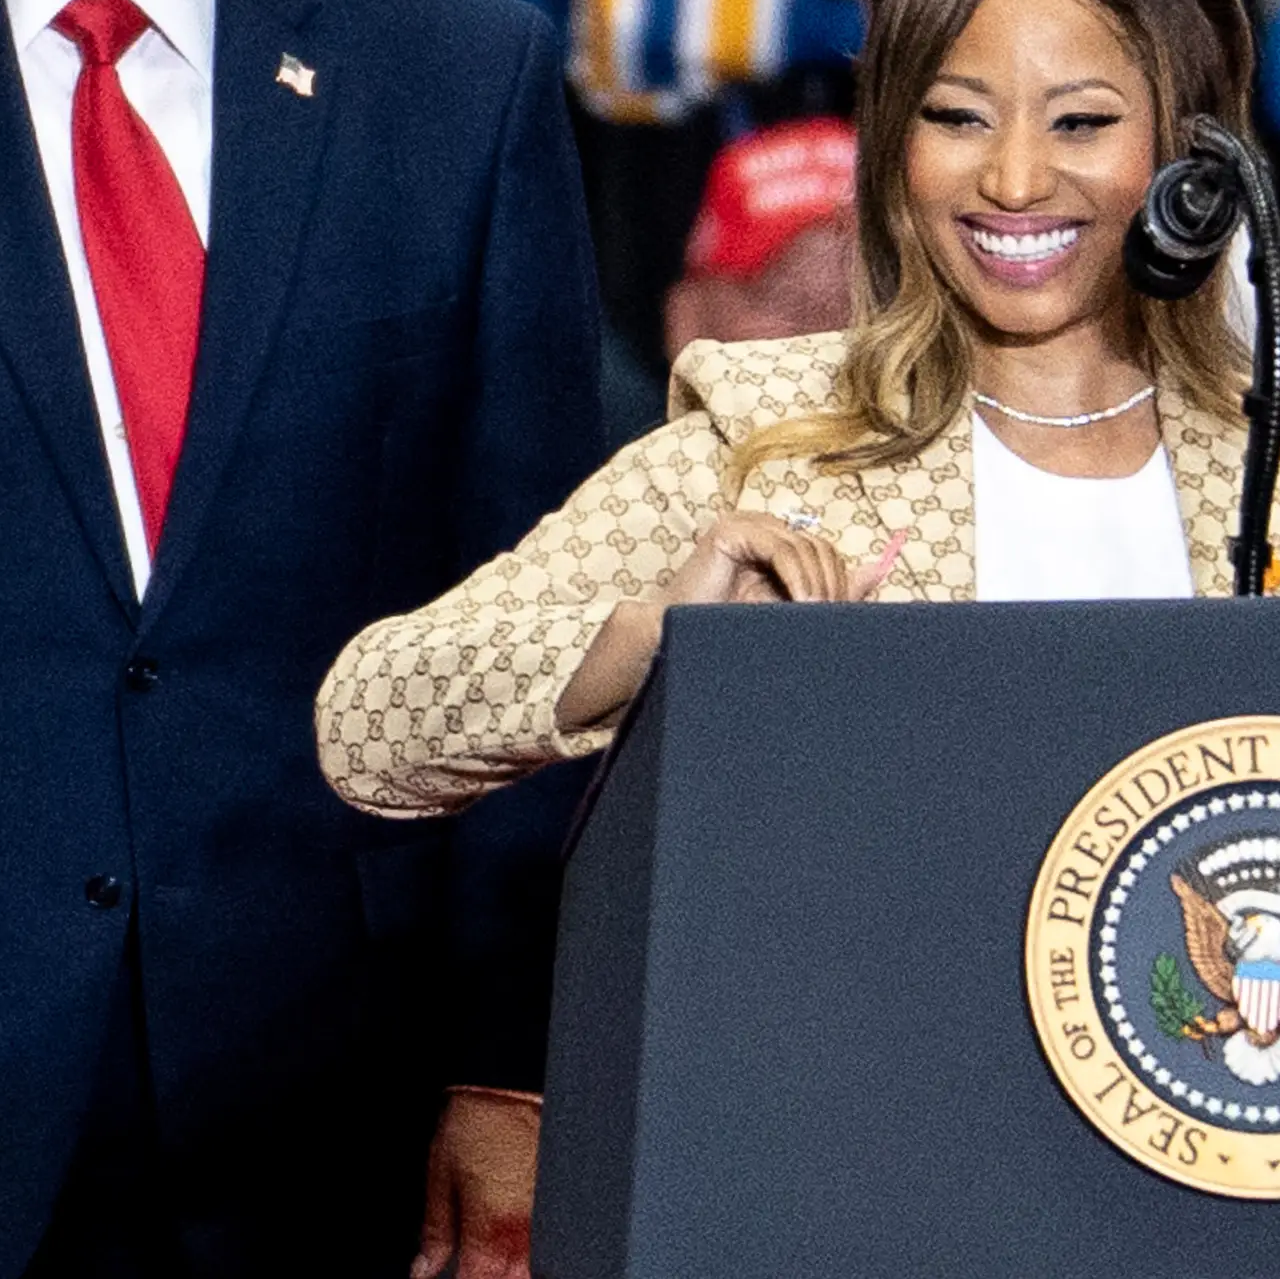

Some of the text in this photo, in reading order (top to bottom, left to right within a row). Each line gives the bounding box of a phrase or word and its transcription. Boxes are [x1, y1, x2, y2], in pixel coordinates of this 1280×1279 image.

[1048, 735, 1270, 928] PRESIDENT
[1049, 946, 1080, 1011] THE
[1062, 1019, 1096, 1061] OF
[1094, 1061, 1208, 1166] SEAL
